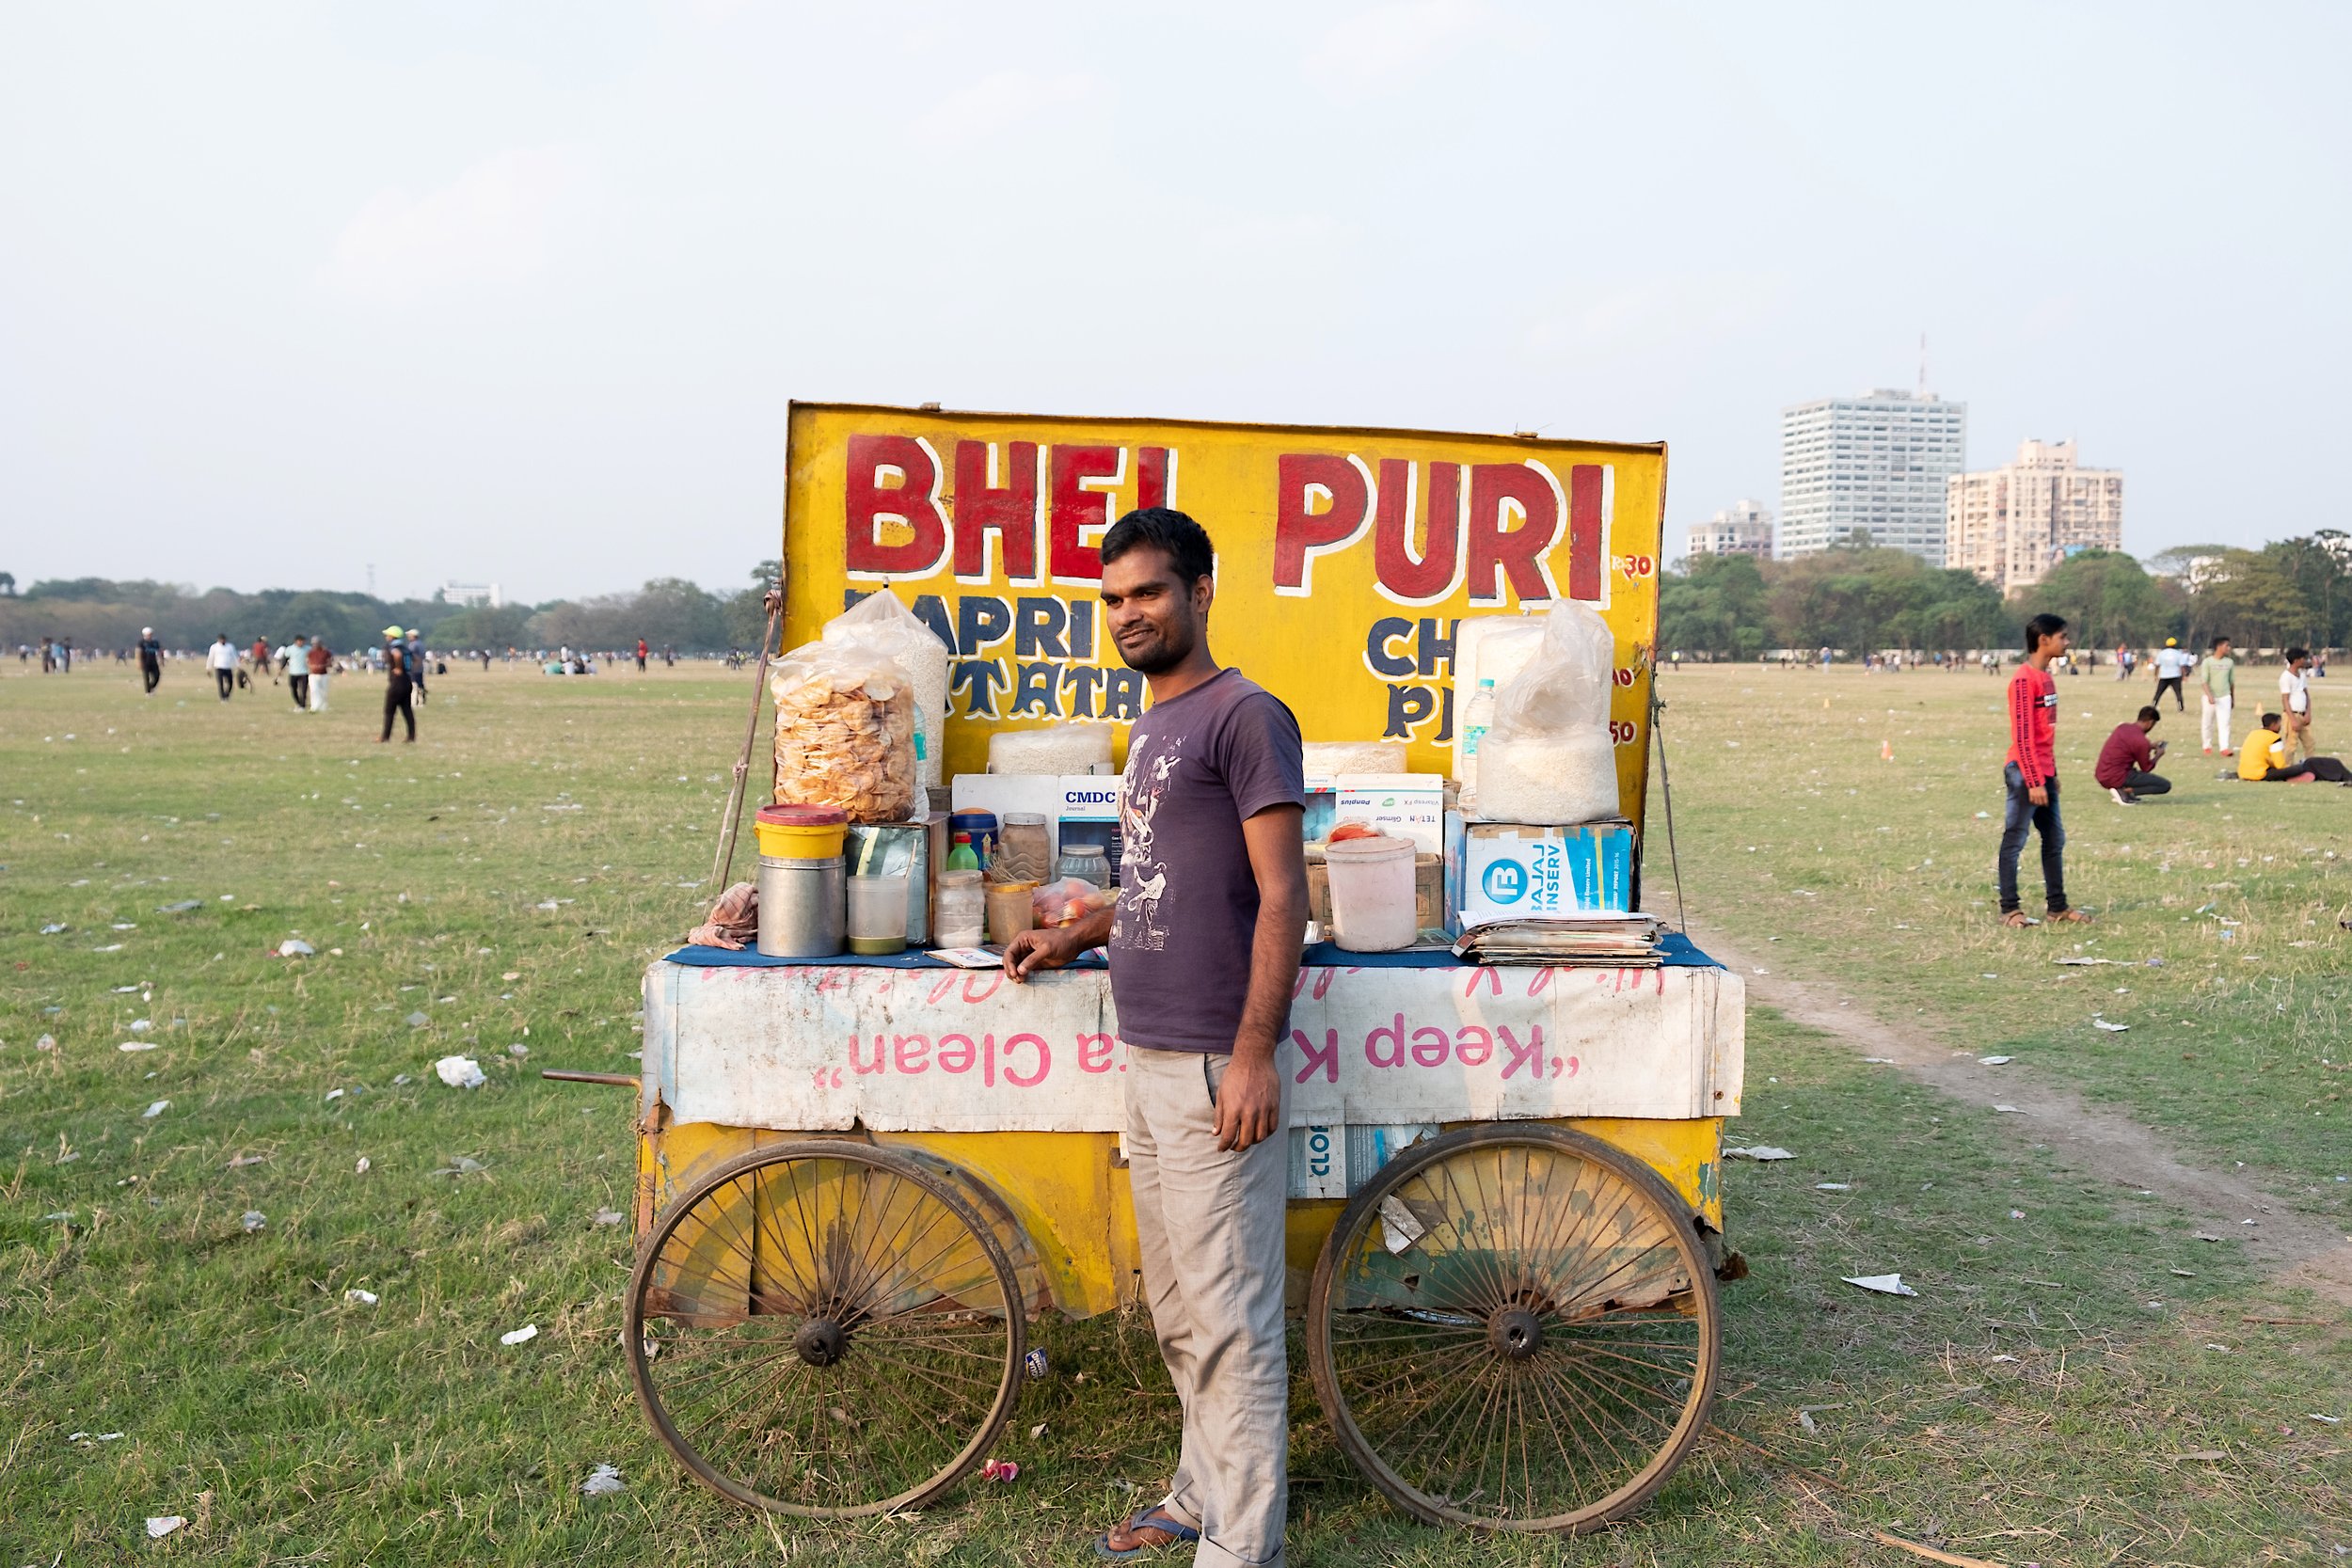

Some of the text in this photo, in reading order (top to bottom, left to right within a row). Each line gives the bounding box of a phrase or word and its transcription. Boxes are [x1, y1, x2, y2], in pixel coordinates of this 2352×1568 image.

[1273, 453, 1614, 610] PURI
[844, 589, 1099, 664] APRI
[944, 657, 1149, 726] TATA
[1065, 791, 1116, 803] CMDC
